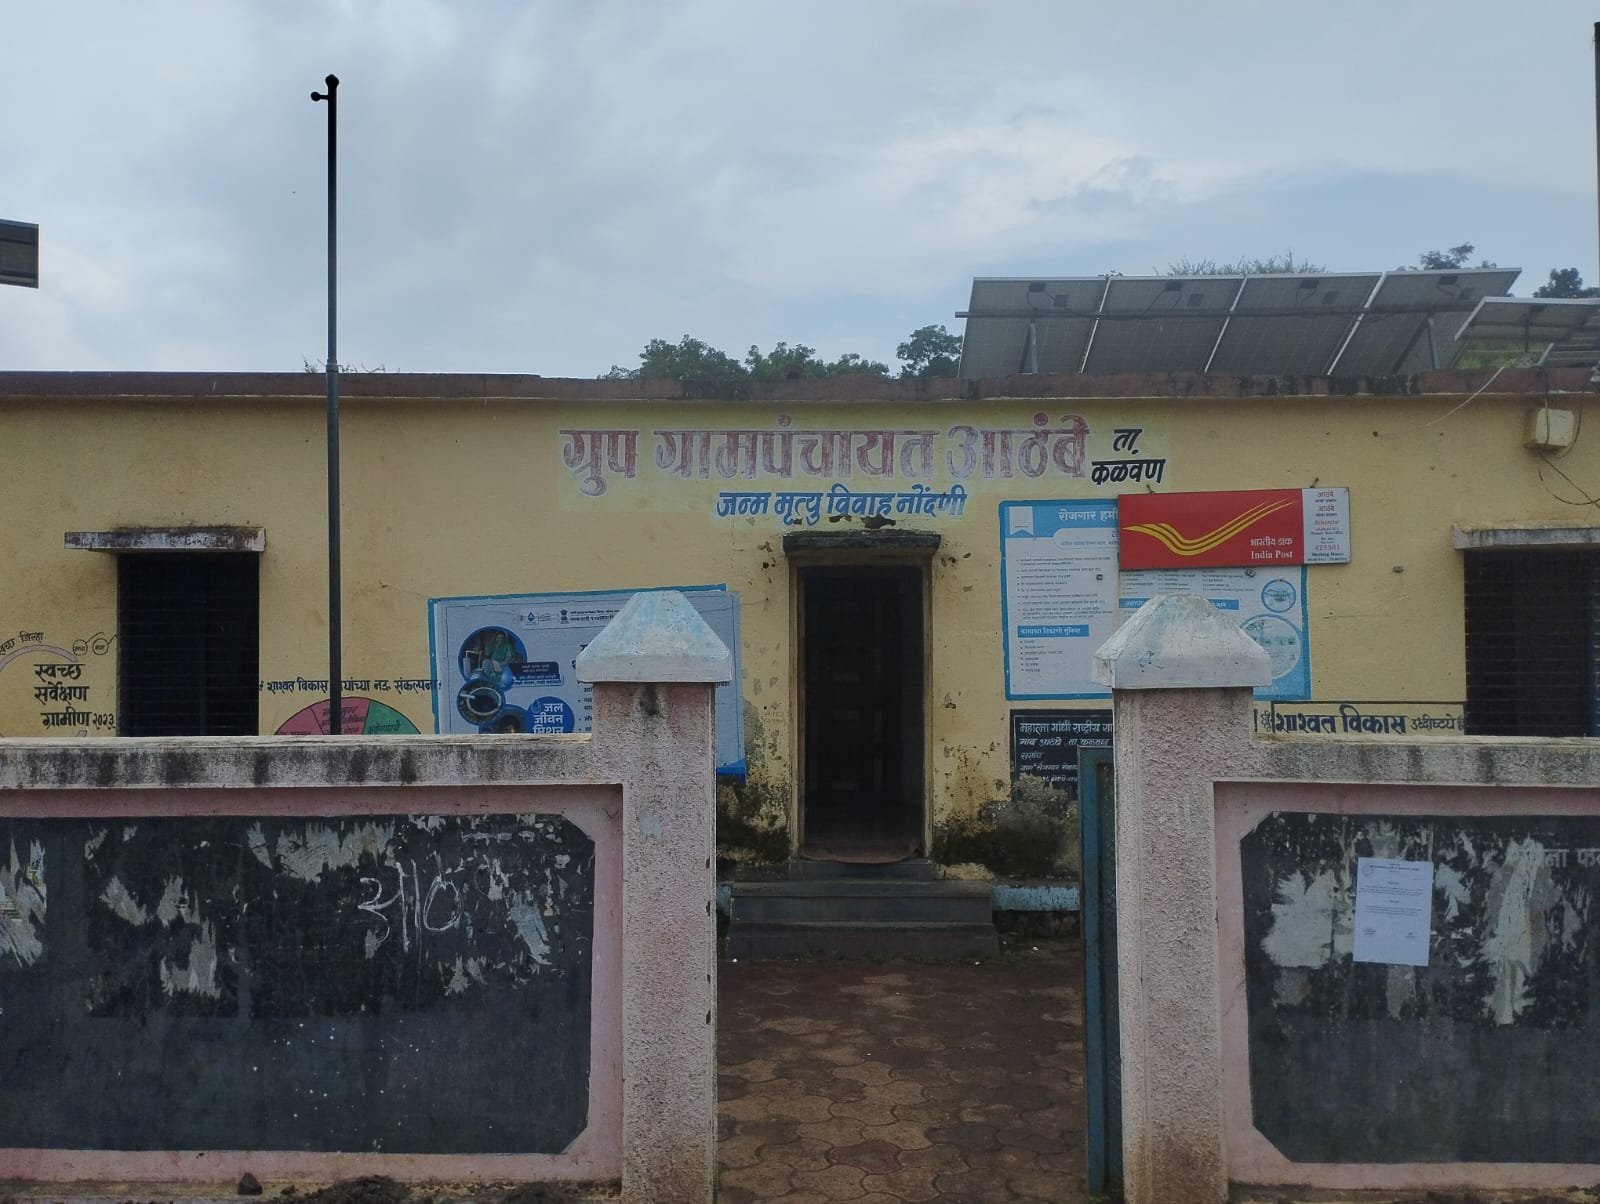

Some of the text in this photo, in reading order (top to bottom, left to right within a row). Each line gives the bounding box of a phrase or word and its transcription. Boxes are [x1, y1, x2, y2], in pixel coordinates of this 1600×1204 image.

[559, 429, 639, 497] ग्रुप
[653, 413, 940, 479] ग्रामपंचायत
[1091, 458, 1166, 485] कळवण
[717, 483, 967, 526] जन्म मृत्यु विवाह नोंदणी
[1250, 535, 1294, 547] भारतीय डाक
[1251, 549, 1293, 559] India Post
[33, 663, 85, 682] स्वच्छ
[297, 676, 328, 694] विकास
[533, 711, 564, 724] जीवन
[543, 703, 564, 713] जल
[40, 706, 92, 730] ग्रामीण
[1275, 712, 1337, 733] शाश्वत
[1338, 704, 1407, 734] विकास
